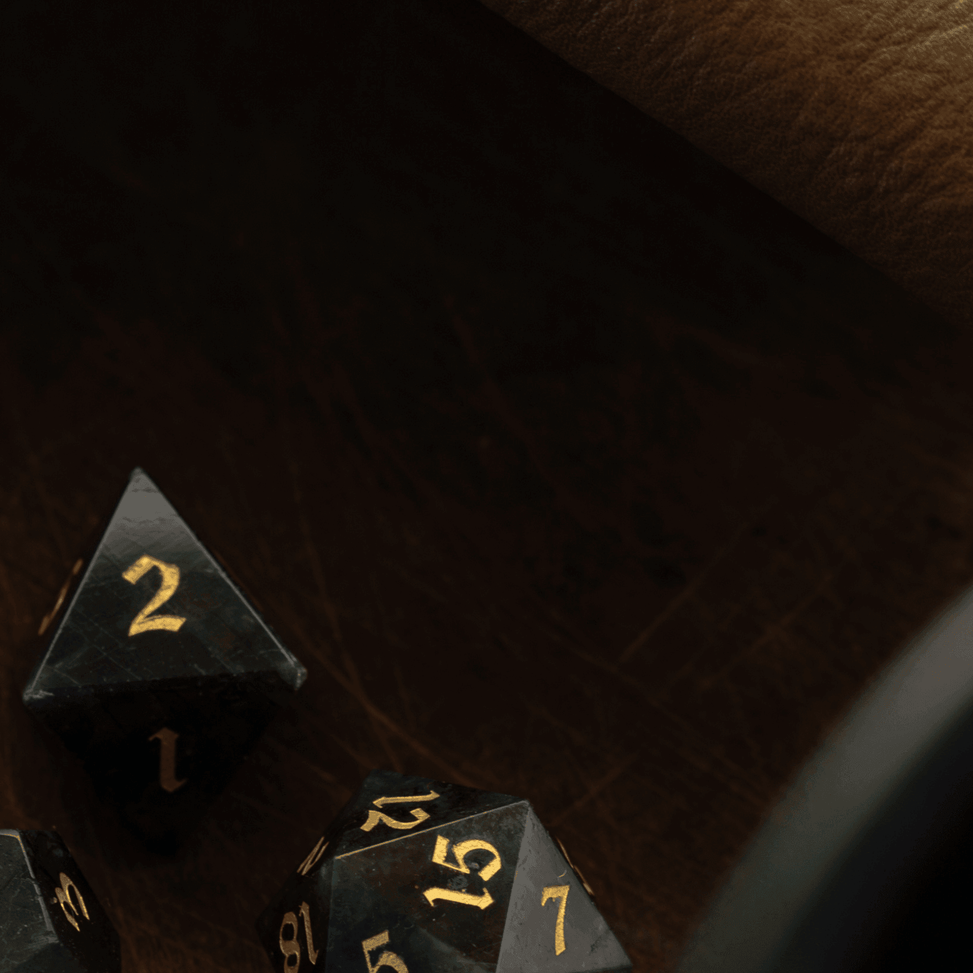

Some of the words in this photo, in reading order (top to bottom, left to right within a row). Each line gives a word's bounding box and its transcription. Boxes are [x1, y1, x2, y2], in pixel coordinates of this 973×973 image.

[122, 554, 187, 636] 2
[146, 726, 188, 793] 1
[360, 790, 440, 832] 12
[54, 871, 90, 932] 3
[423, 834, 502, 910] 15
[540, 884, 571, 956] 7
